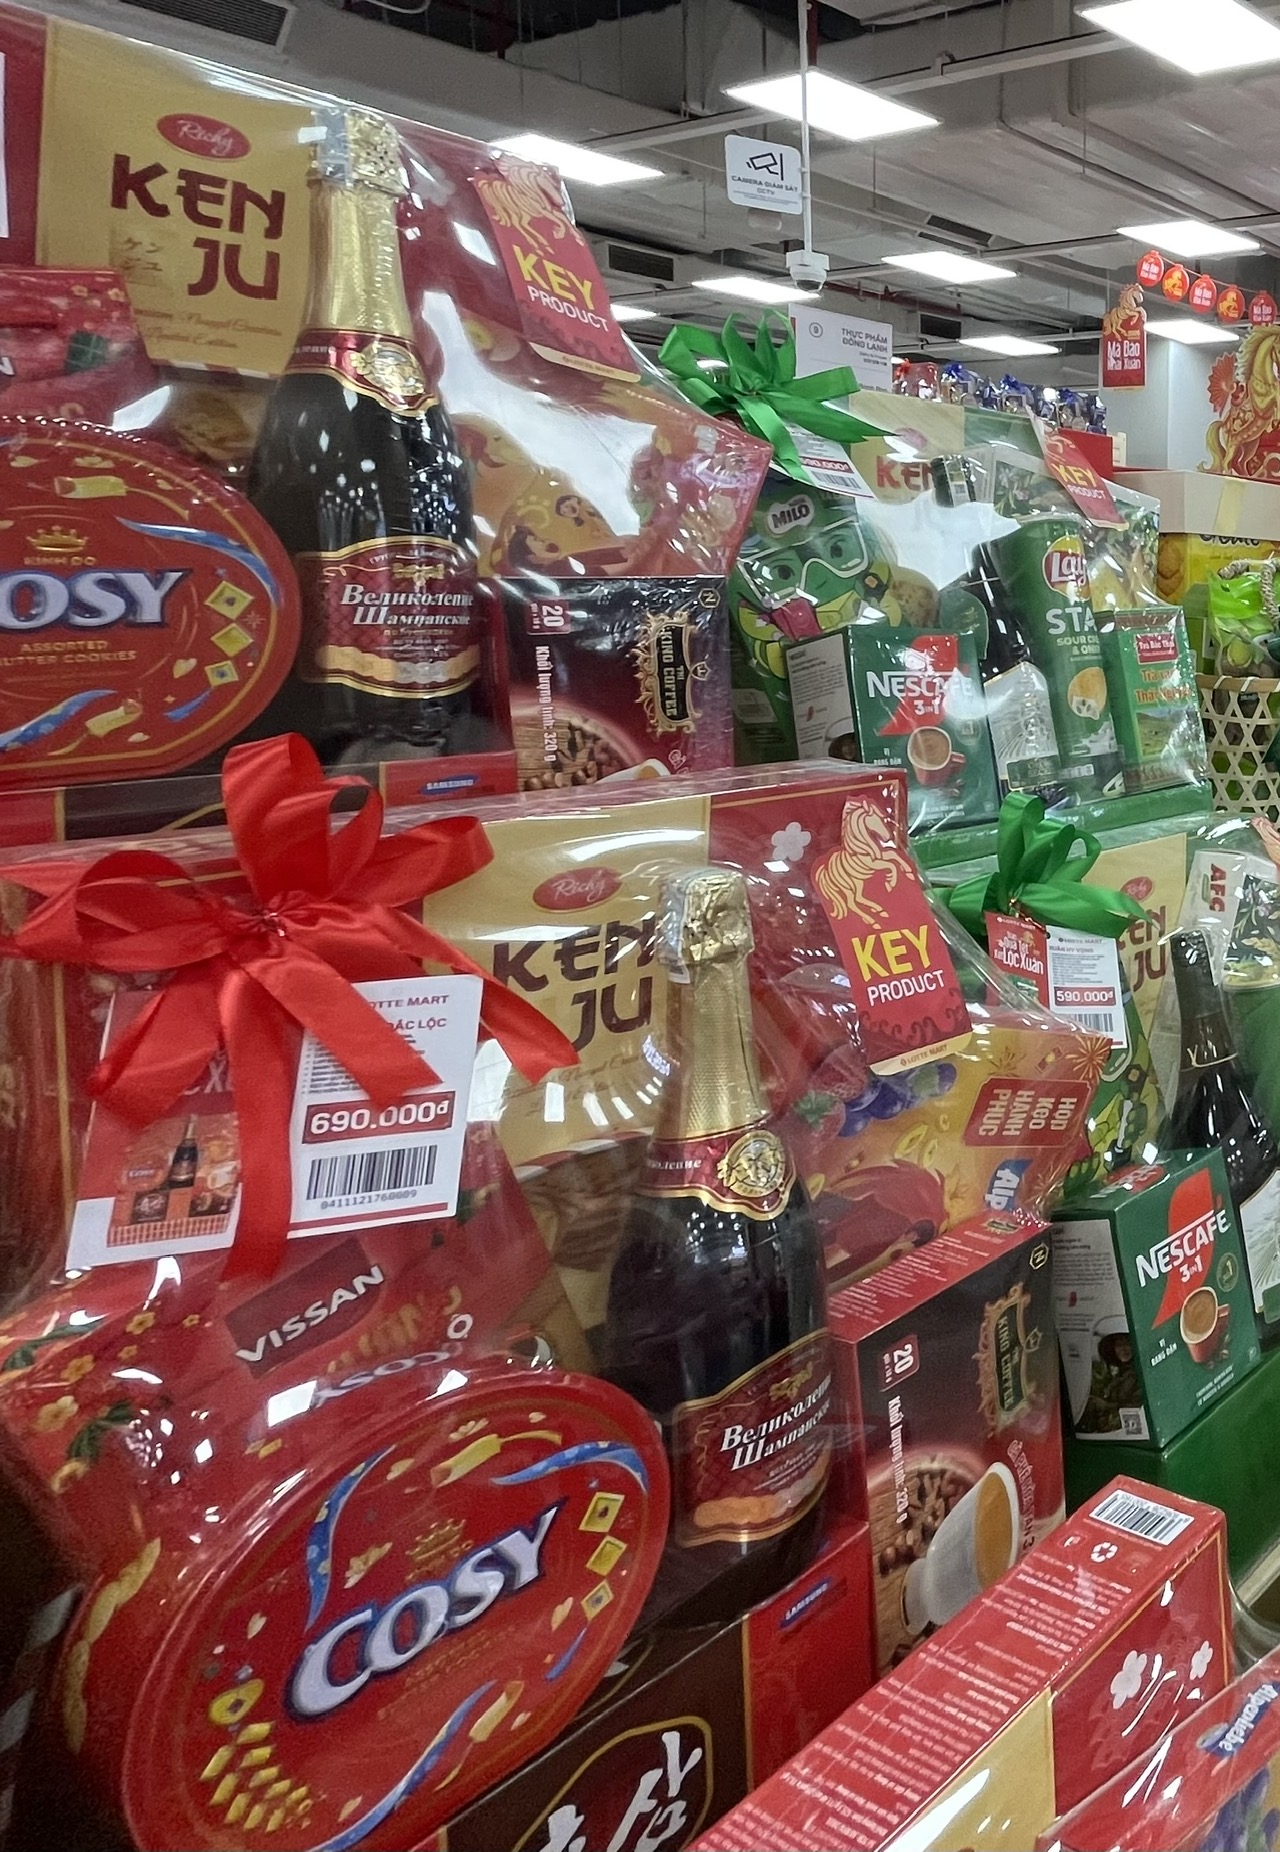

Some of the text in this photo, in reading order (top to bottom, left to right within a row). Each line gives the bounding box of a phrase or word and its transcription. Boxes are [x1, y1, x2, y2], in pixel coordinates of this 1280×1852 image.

[111, 154, 285, 239] KEN
[731, 175, 763, 186] CAMERA
[757, 187, 775, 195] CCTV
[188, 237, 280, 300] JU
[513, 245, 594, 310] KEY
[527, 286, 609, 331] PRODUCT
[1053, 463, 1096, 489] KEY
[1067, 483, 1107, 500] PRODUCT
[772, 504, 811, 528] MILO
[1051, 552, 1086, 586] Lay
[0, 570, 184, 630] OSY
[542, 604, 565, 628] 20
[1046, 606, 1095, 635] STA
[0, 651, 137, 666] UTTER COOKIES
[20, 640, 108, 652] ASSORTED
[1056, 635, 1082, 647] SOUR
[659, 630, 679, 717] KING COFFEE
[543, 731, 558, 751] 320
[553, 876, 606, 902] Richy
[1208, 864, 1227, 912] AFC
[493, 912, 656, 992] KEN
[852, 925, 931, 982] KEY
[1133, 948, 1167, 992] JU
[369, 994, 450, 1009] OTTE MART
[867, 970, 944, 1006] PRODUCT
[417, 1017, 448, 1032] LỘC
[571, 976, 653, 1051] JU
[906, 1051, 928, 1065] LOTTE
[310, 1099, 450, 1135] 690.000đ
[985, 1167, 1020, 1212] Alp
[235, 1264, 384, 1362] VISSAN
[892, 1343, 914, 1375] 20
[287, 1504, 561, 1718] COSY
[785, 1582, 828, 1621] SAMSUNG
